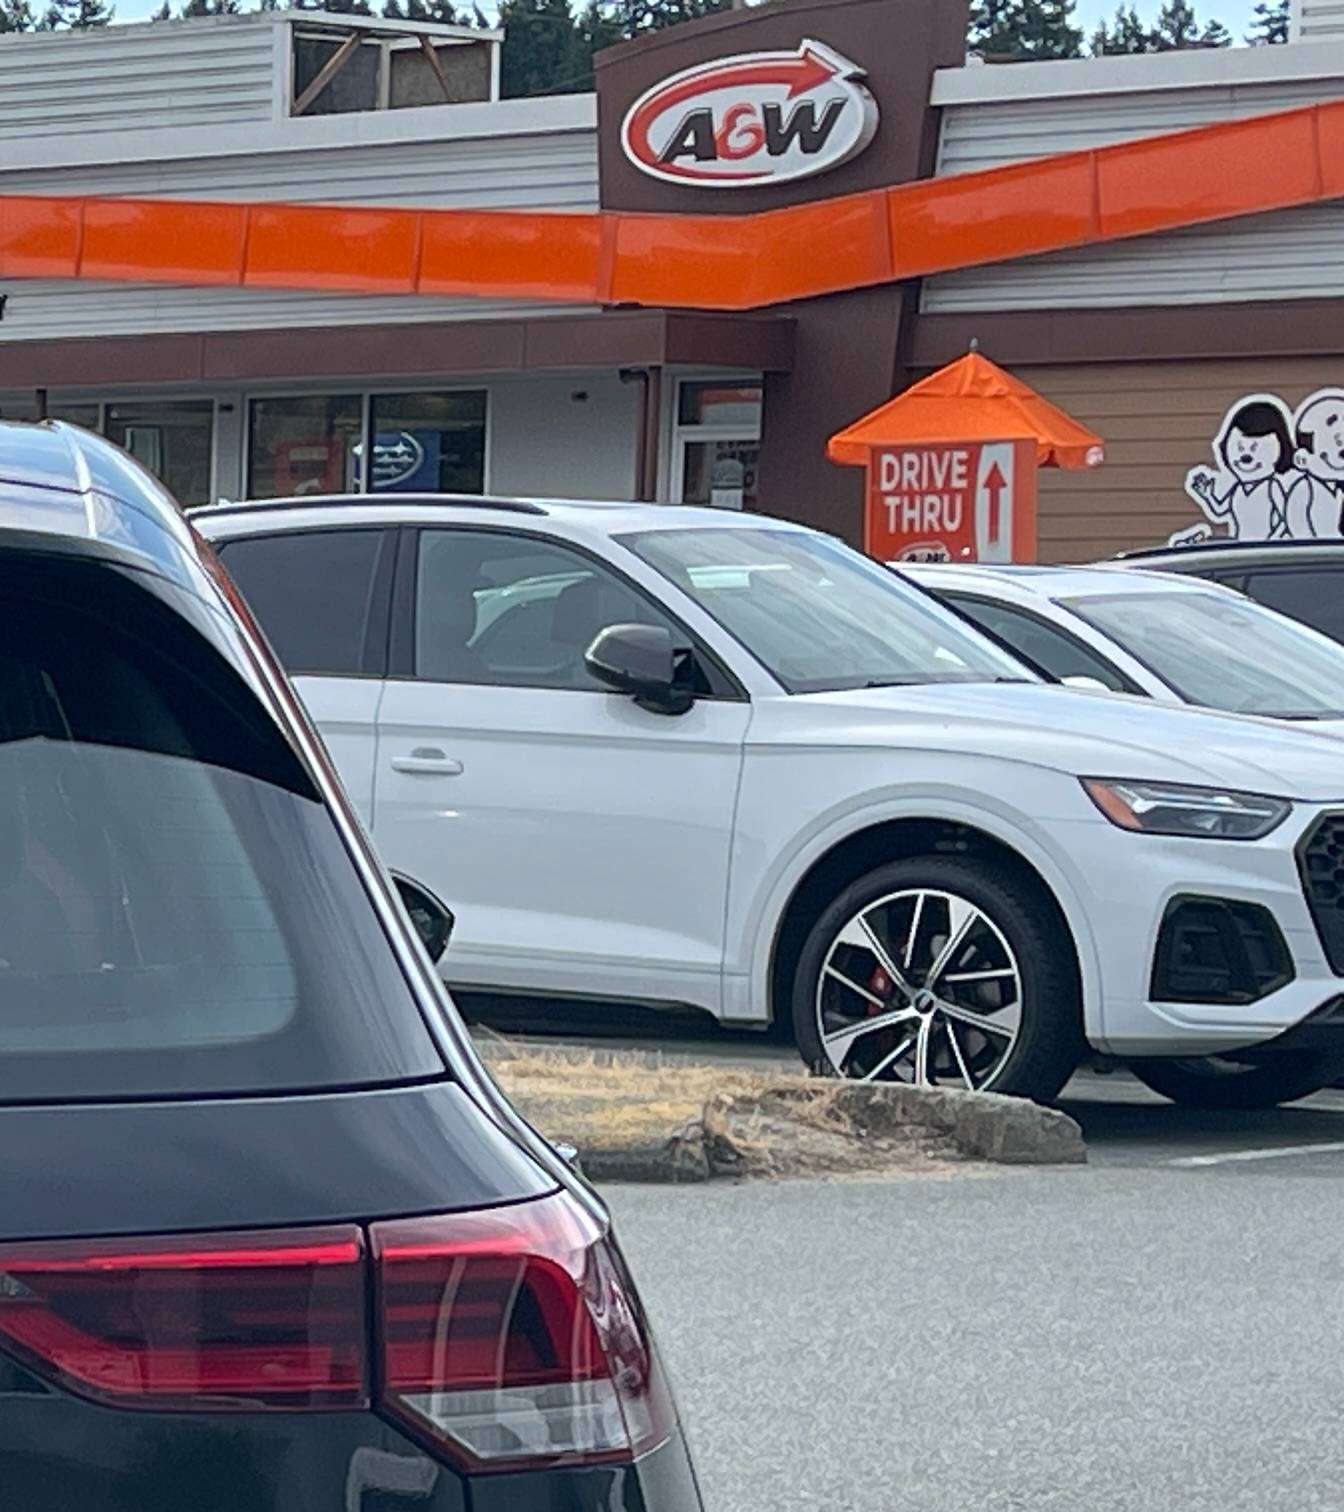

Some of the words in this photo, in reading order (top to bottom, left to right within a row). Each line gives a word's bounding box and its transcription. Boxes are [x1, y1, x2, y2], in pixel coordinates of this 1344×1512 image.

[656, 97, 849, 162] A&W
[880, 451, 969, 491] DRIVE
[884, 495, 962, 533] THRU
